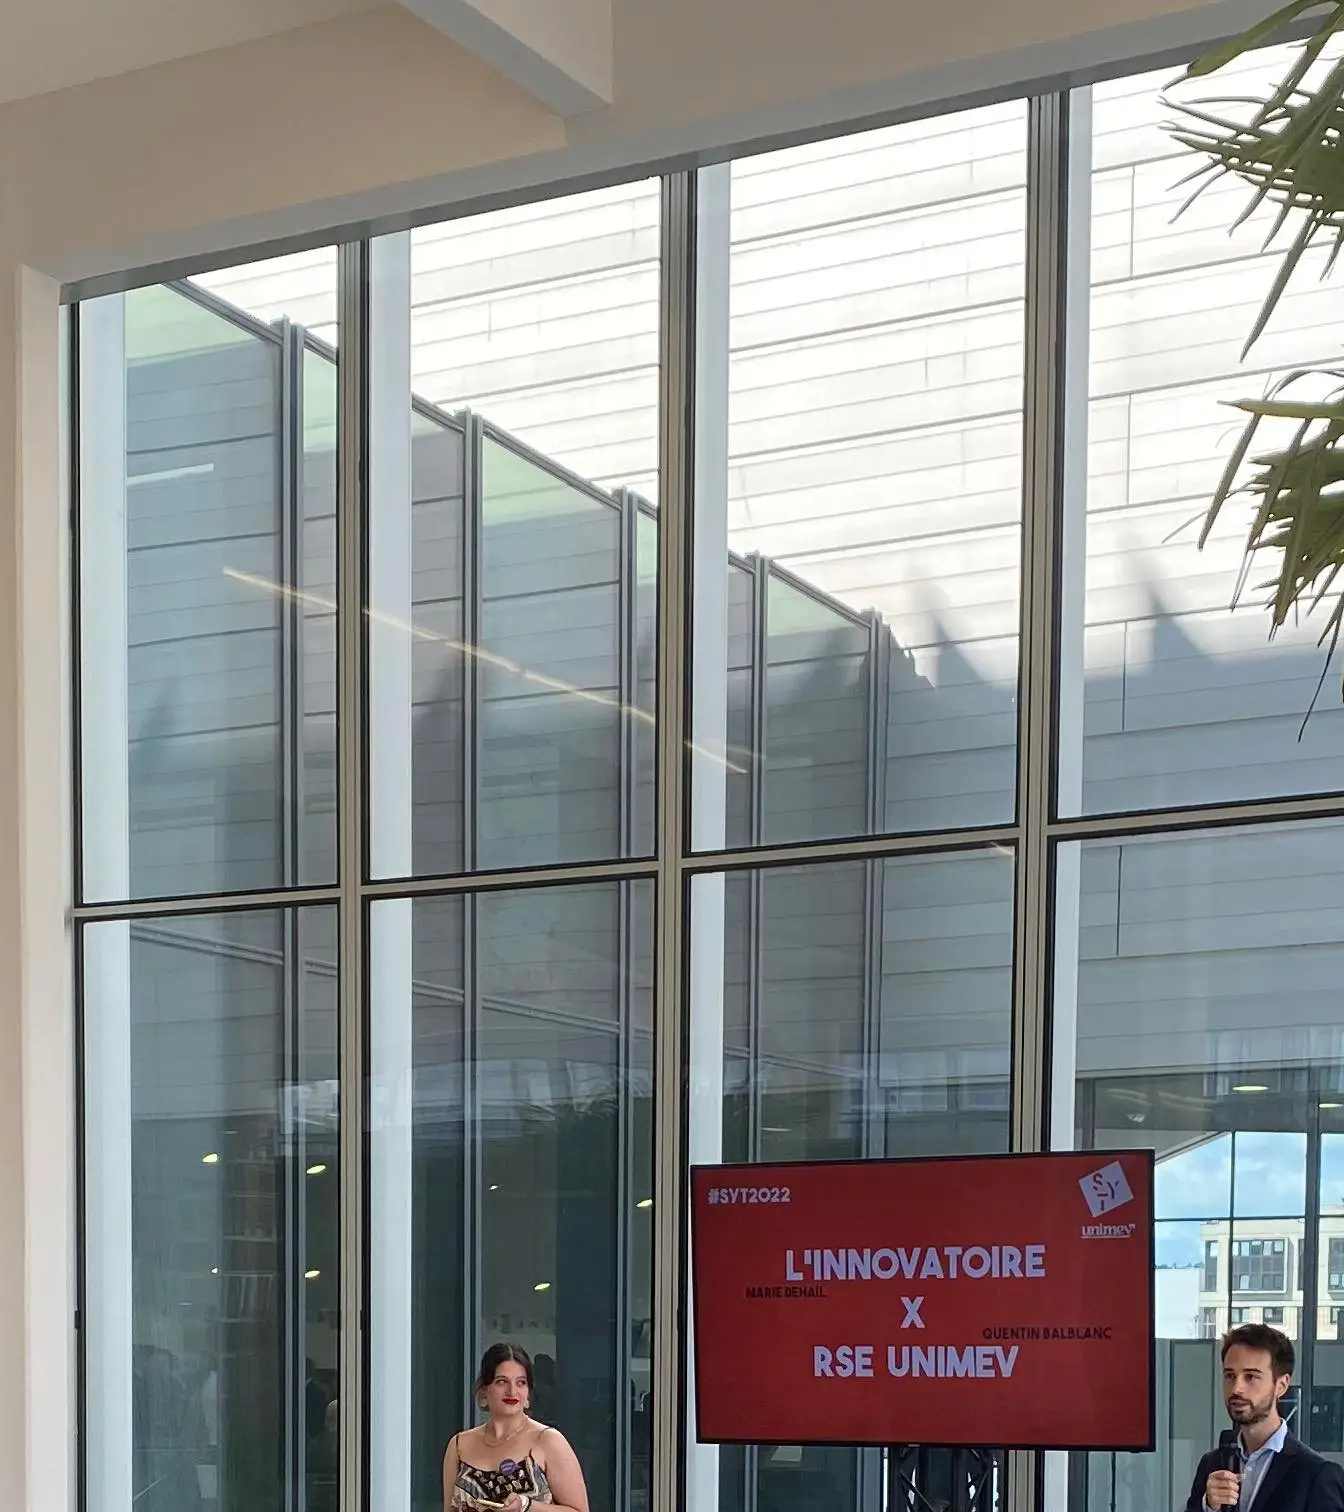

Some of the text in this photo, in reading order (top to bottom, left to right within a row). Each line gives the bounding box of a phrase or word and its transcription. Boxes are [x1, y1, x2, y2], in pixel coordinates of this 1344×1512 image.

[708, 1187, 791, 1204] #SYT2022
[785, 1246, 1045, 1281] L'INNOVATOIRE
[900, 1296, 926, 1329] X
[982, 1327, 1040, 1341] QUENTIN
[813, 1345, 1019, 1378] RSE UNIMEV
